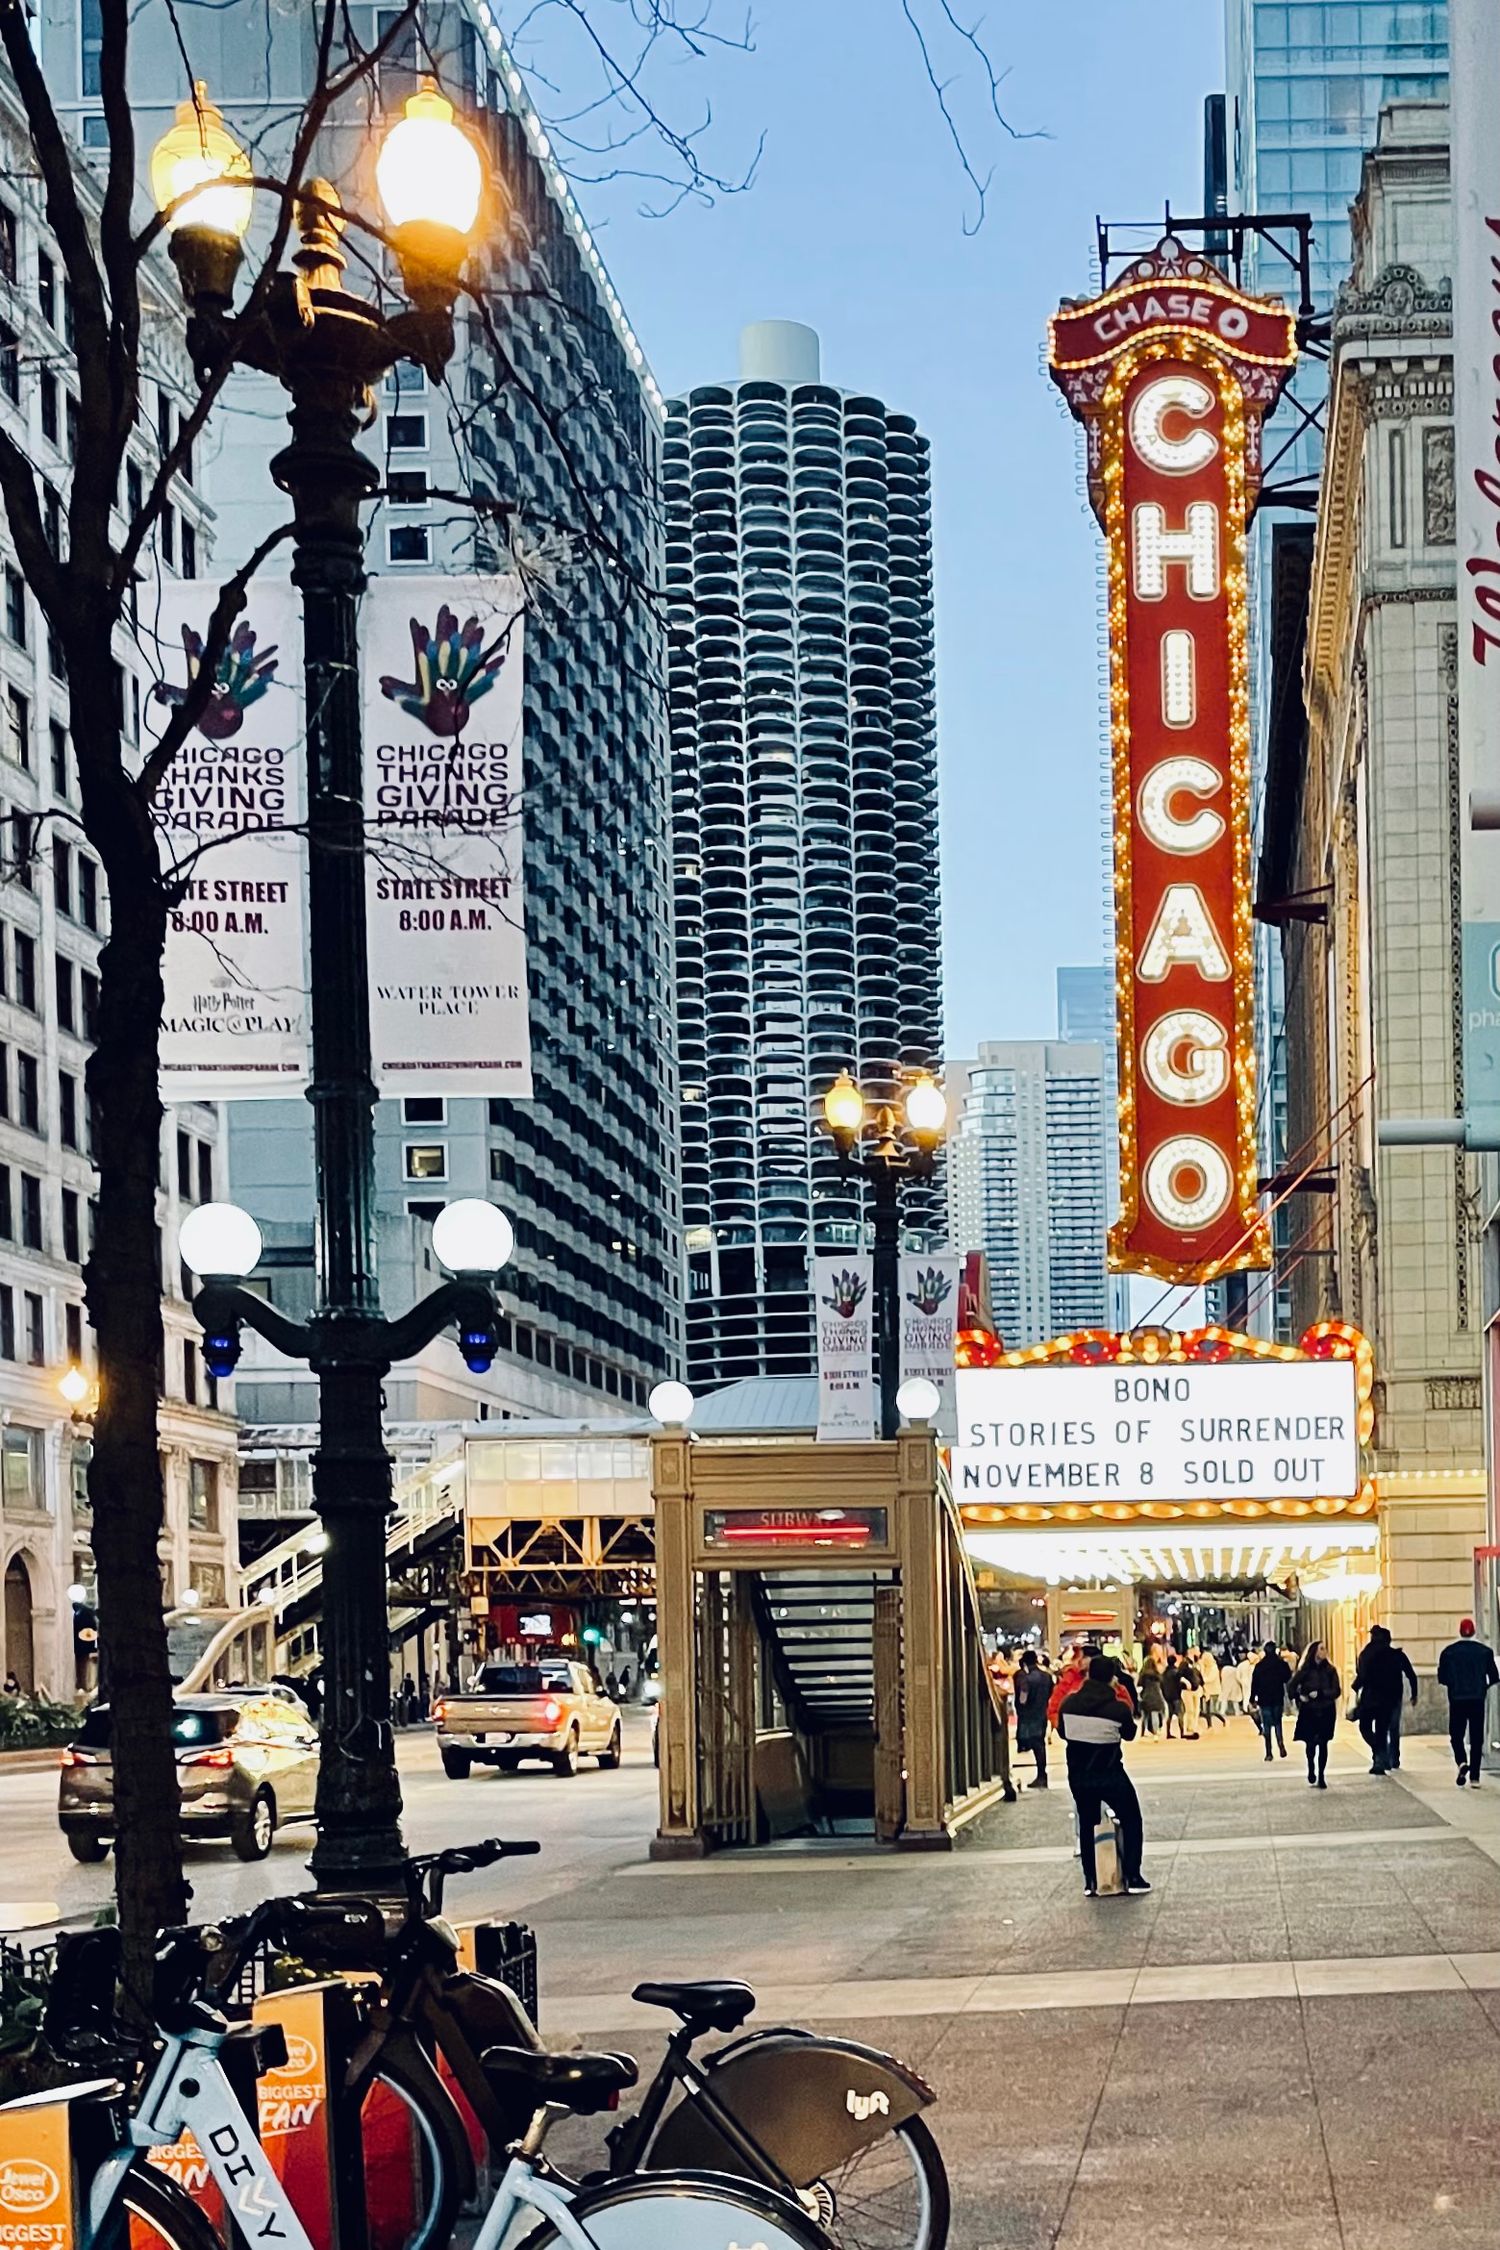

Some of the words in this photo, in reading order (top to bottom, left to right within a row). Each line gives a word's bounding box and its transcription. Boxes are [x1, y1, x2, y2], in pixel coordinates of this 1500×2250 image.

[1094, 294, 1213, 341] CHASE
[172, 746, 284, 765] HICAGO
[377, 743, 508, 762] CHICAGO
[171, 766, 285, 786] HANKS
[377, 762, 508, 783] THANKS
[154, 787, 285, 810] GIVING
[377, 783, 508, 807] GIVING
[1127, 373, 1234, 1233] CHICAGO
[155, 811, 285, 830] PARADE
[378, 808, 508, 828] PARADE
[214, 880, 288, 903] STREET
[377, 878, 435, 900] STATE
[441, 877, 511, 899] STREET
[172, 911, 218, 933] 8:00
[225, 912, 268, 934] A.M.
[400, 910, 444, 931] 8:00
[450, 909, 491, 930] A.M.
[377, 986, 442, 1000] WATER
[450, 985, 519, 999] TOWER
[419, 1002, 479, 1016] PLACE
[1114, 1378, 1190, 1403] BONO
[970, 1421, 1095, 1447] STORIES
[1115, 1420, 1151, 1444] OF
[1180, 1416, 1345, 1443] SURRENDER
[963, 1463, 1120, 1489] NOVEMBER
[1140, 1462, 1154, 1485] 8
[1184, 1459, 1254, 1485] SOLD
[1274, 1458, 1325, 1483] OUT
[761, 1512, 828, 1527] SUBWA
[257, 2084, 323, 2100] BIGGEST
[259, 2098, 322, 2130] FAN
[846, 2089, 890, 2120] lyft
